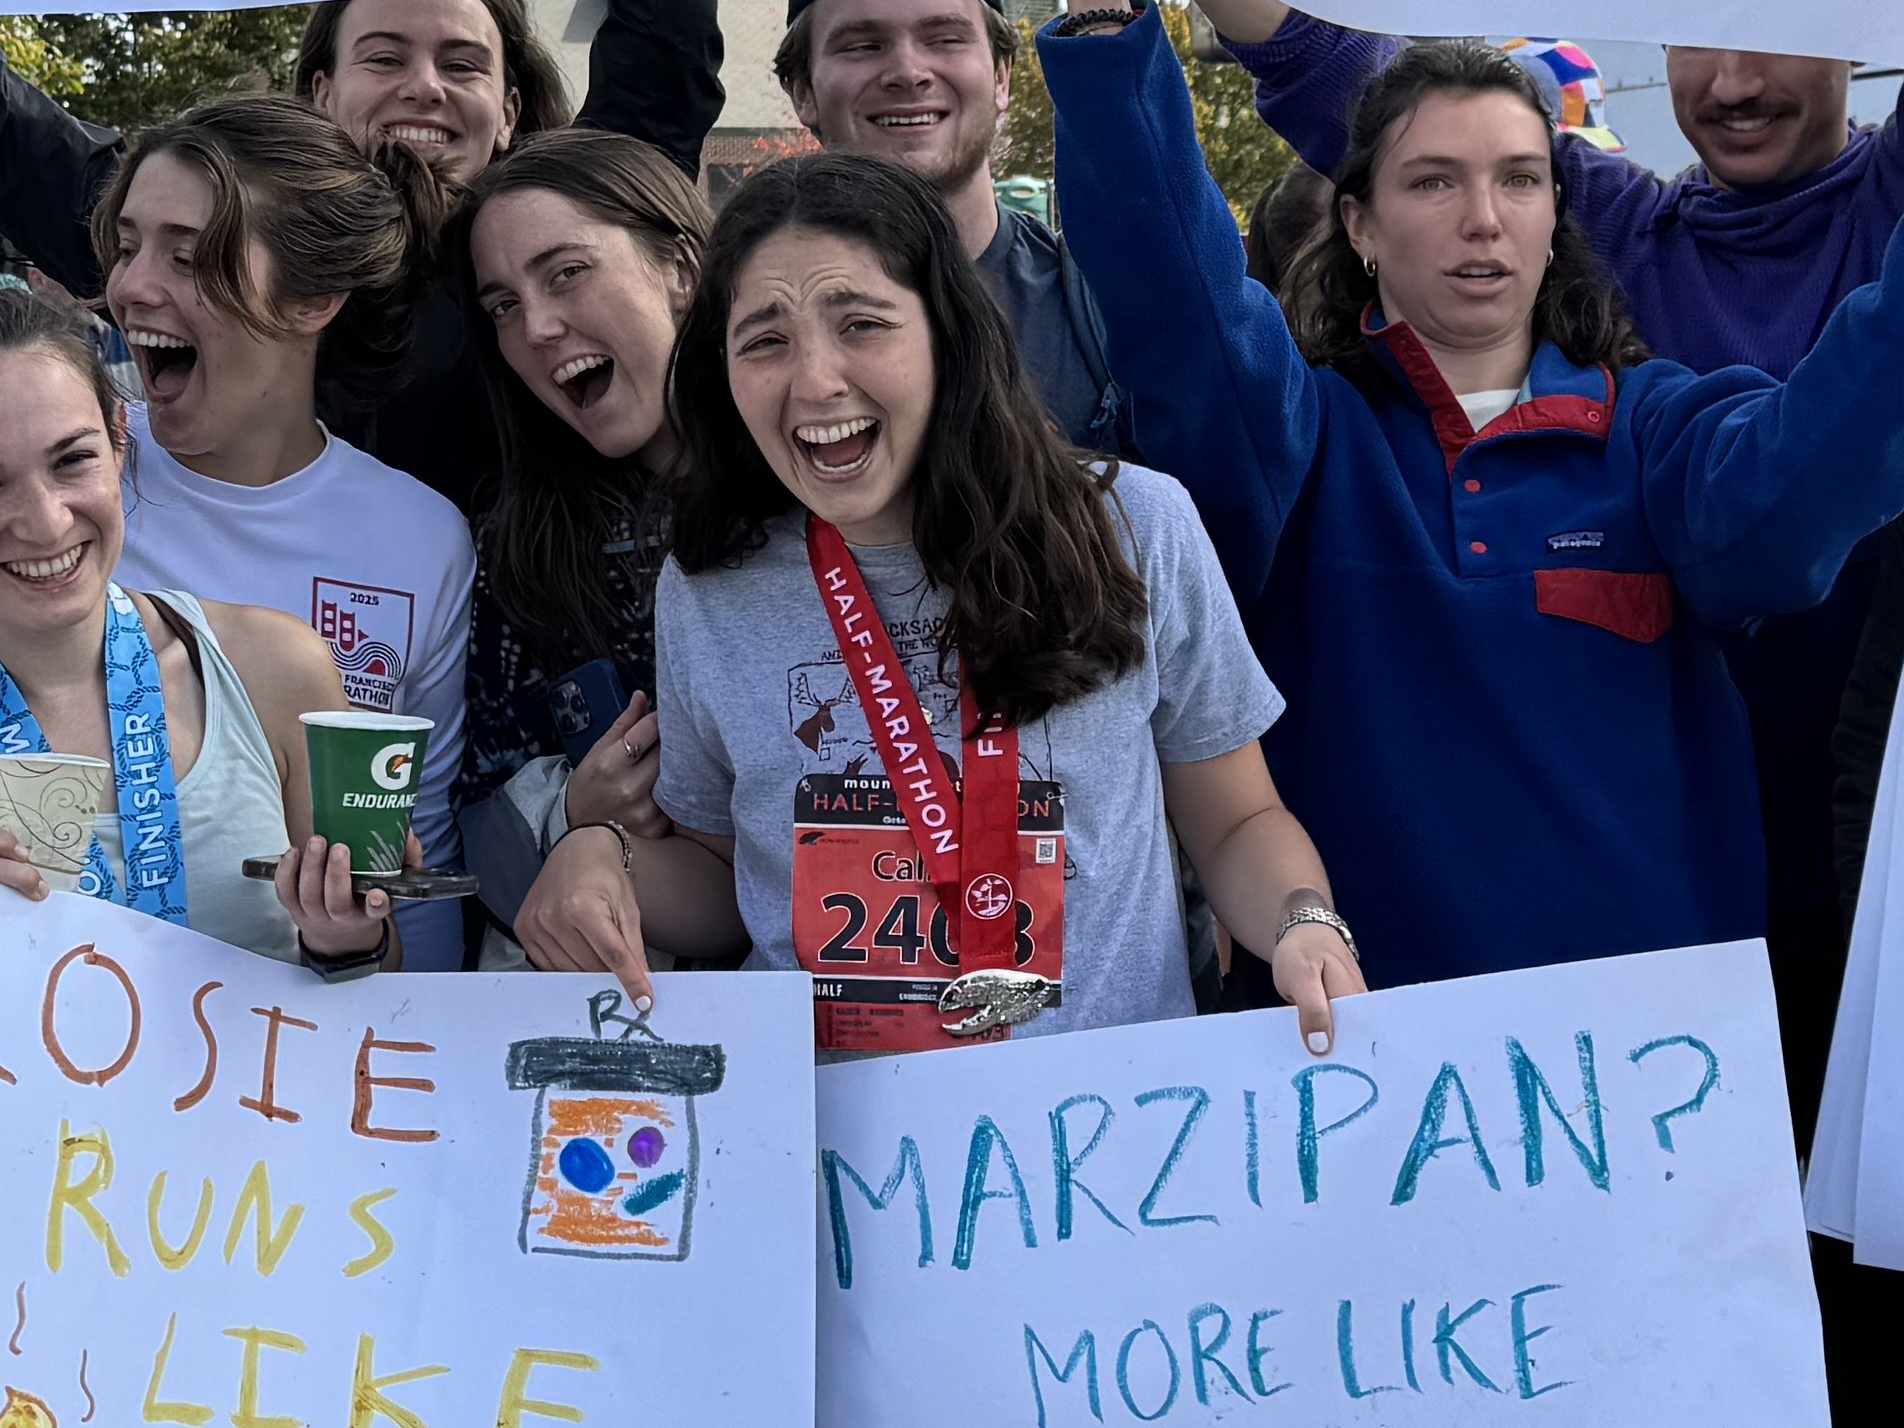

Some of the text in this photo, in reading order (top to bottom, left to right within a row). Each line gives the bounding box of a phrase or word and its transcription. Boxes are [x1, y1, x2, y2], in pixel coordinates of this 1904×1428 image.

[825, 567, 960, 854] HALF-MARATHON
[124, 711, 169, 888] FINISHER
[46, 1117, 398, 1278] RUNS
[820, 1029, 1729, 1289] MARZIPAN?
[1337, 1284, 1577, 1401] LIKE
